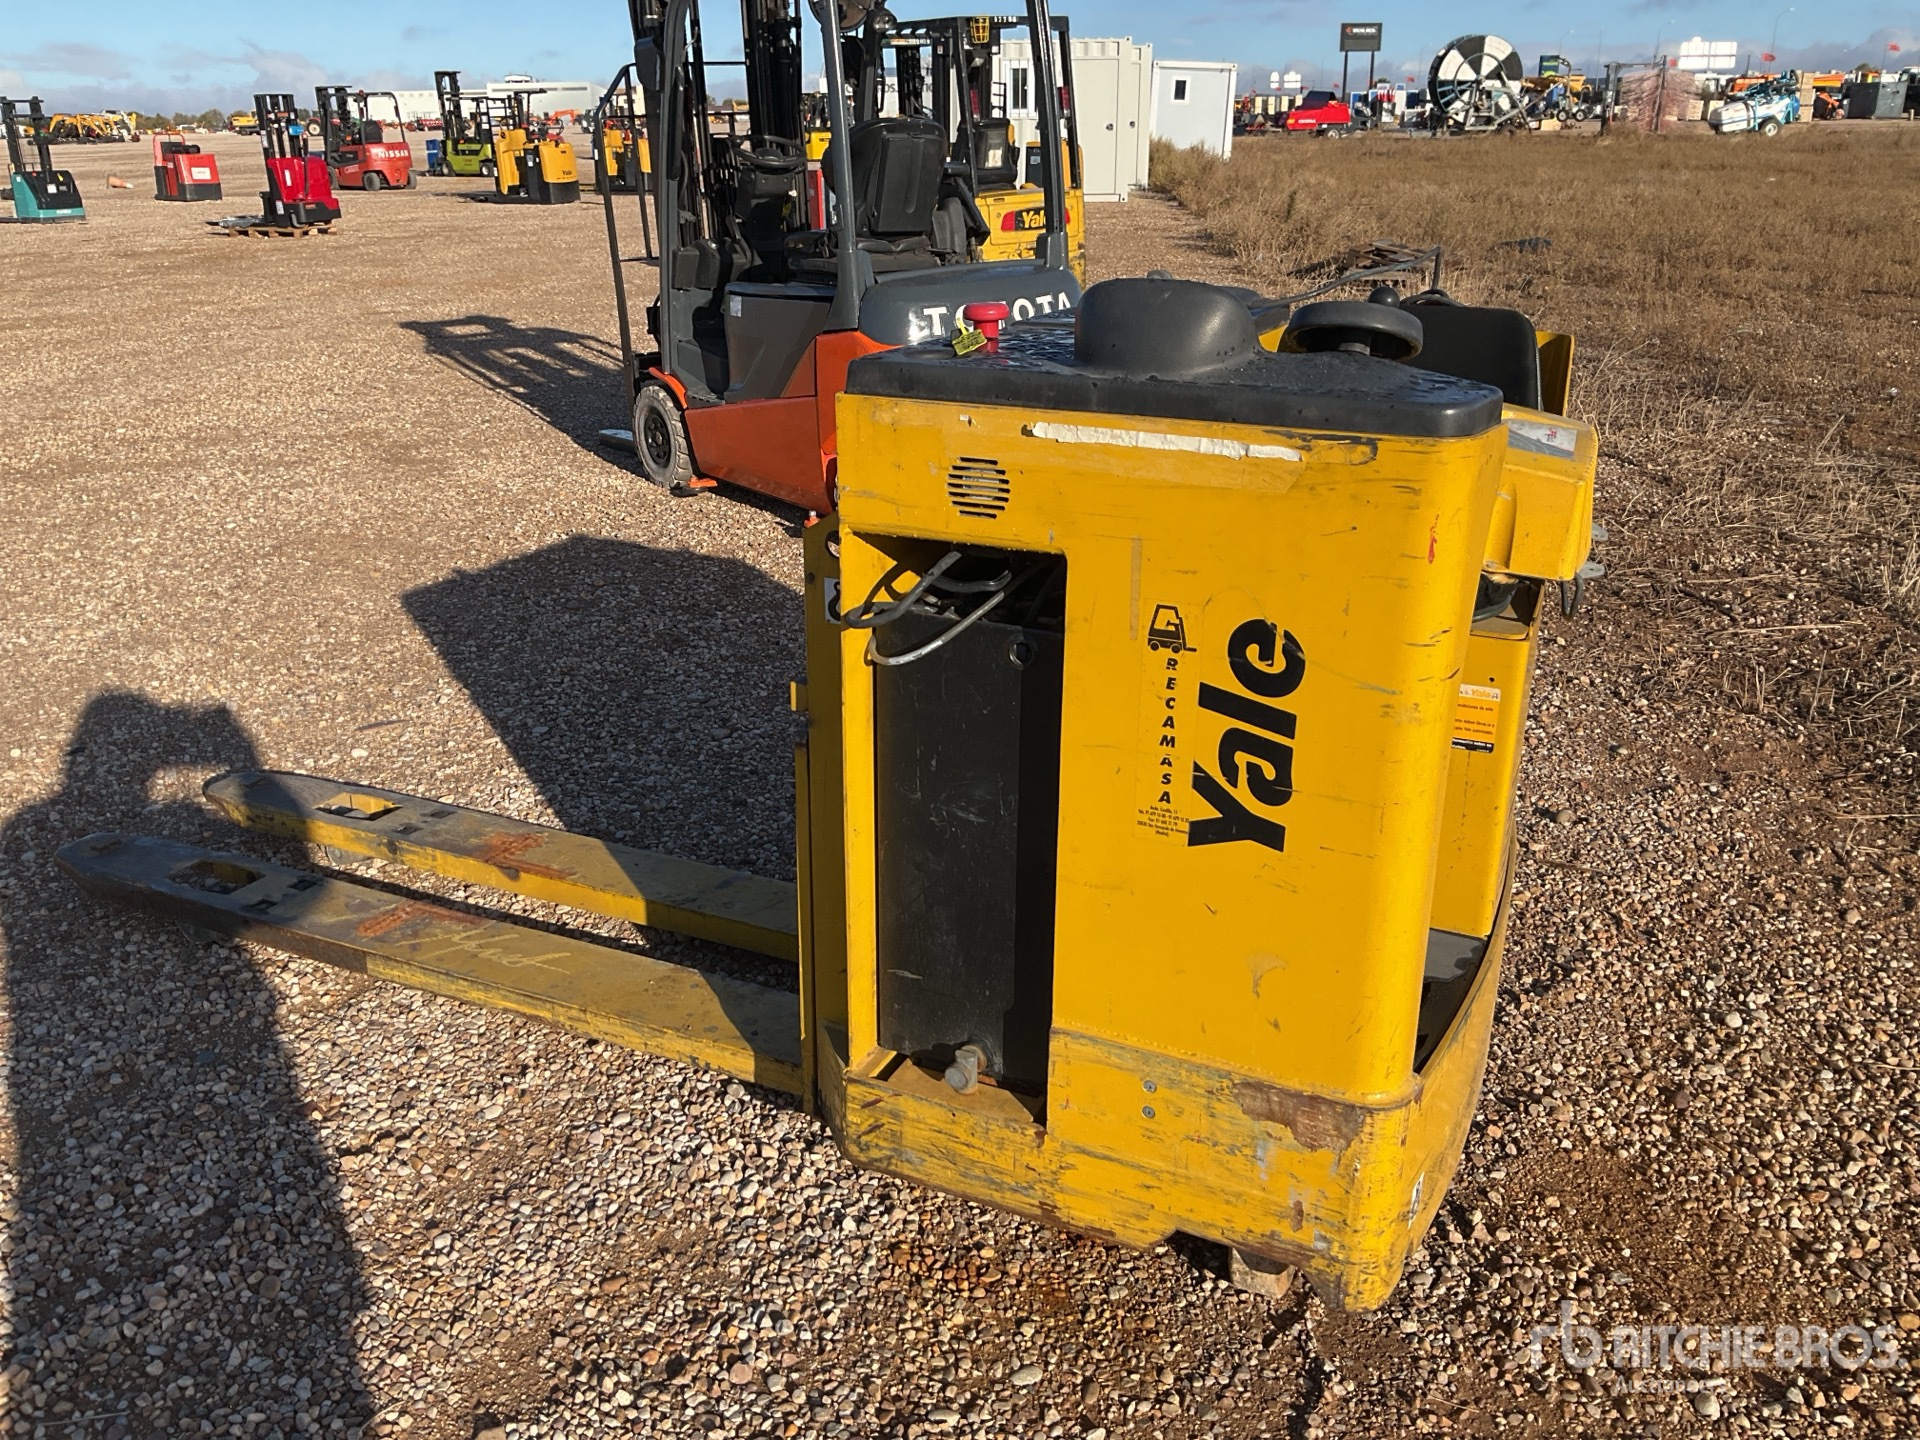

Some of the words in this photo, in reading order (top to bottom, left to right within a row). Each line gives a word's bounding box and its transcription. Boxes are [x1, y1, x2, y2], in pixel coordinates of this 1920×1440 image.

[378, 150, 409, 158] NISSAN
[1022, 210, 1046, 228] Yal
[923, 292, 1071, 336] TOOTA
[1158, 657, 1178, 804] RECAMASA
[1188, 618, 1307, 852] Yale
